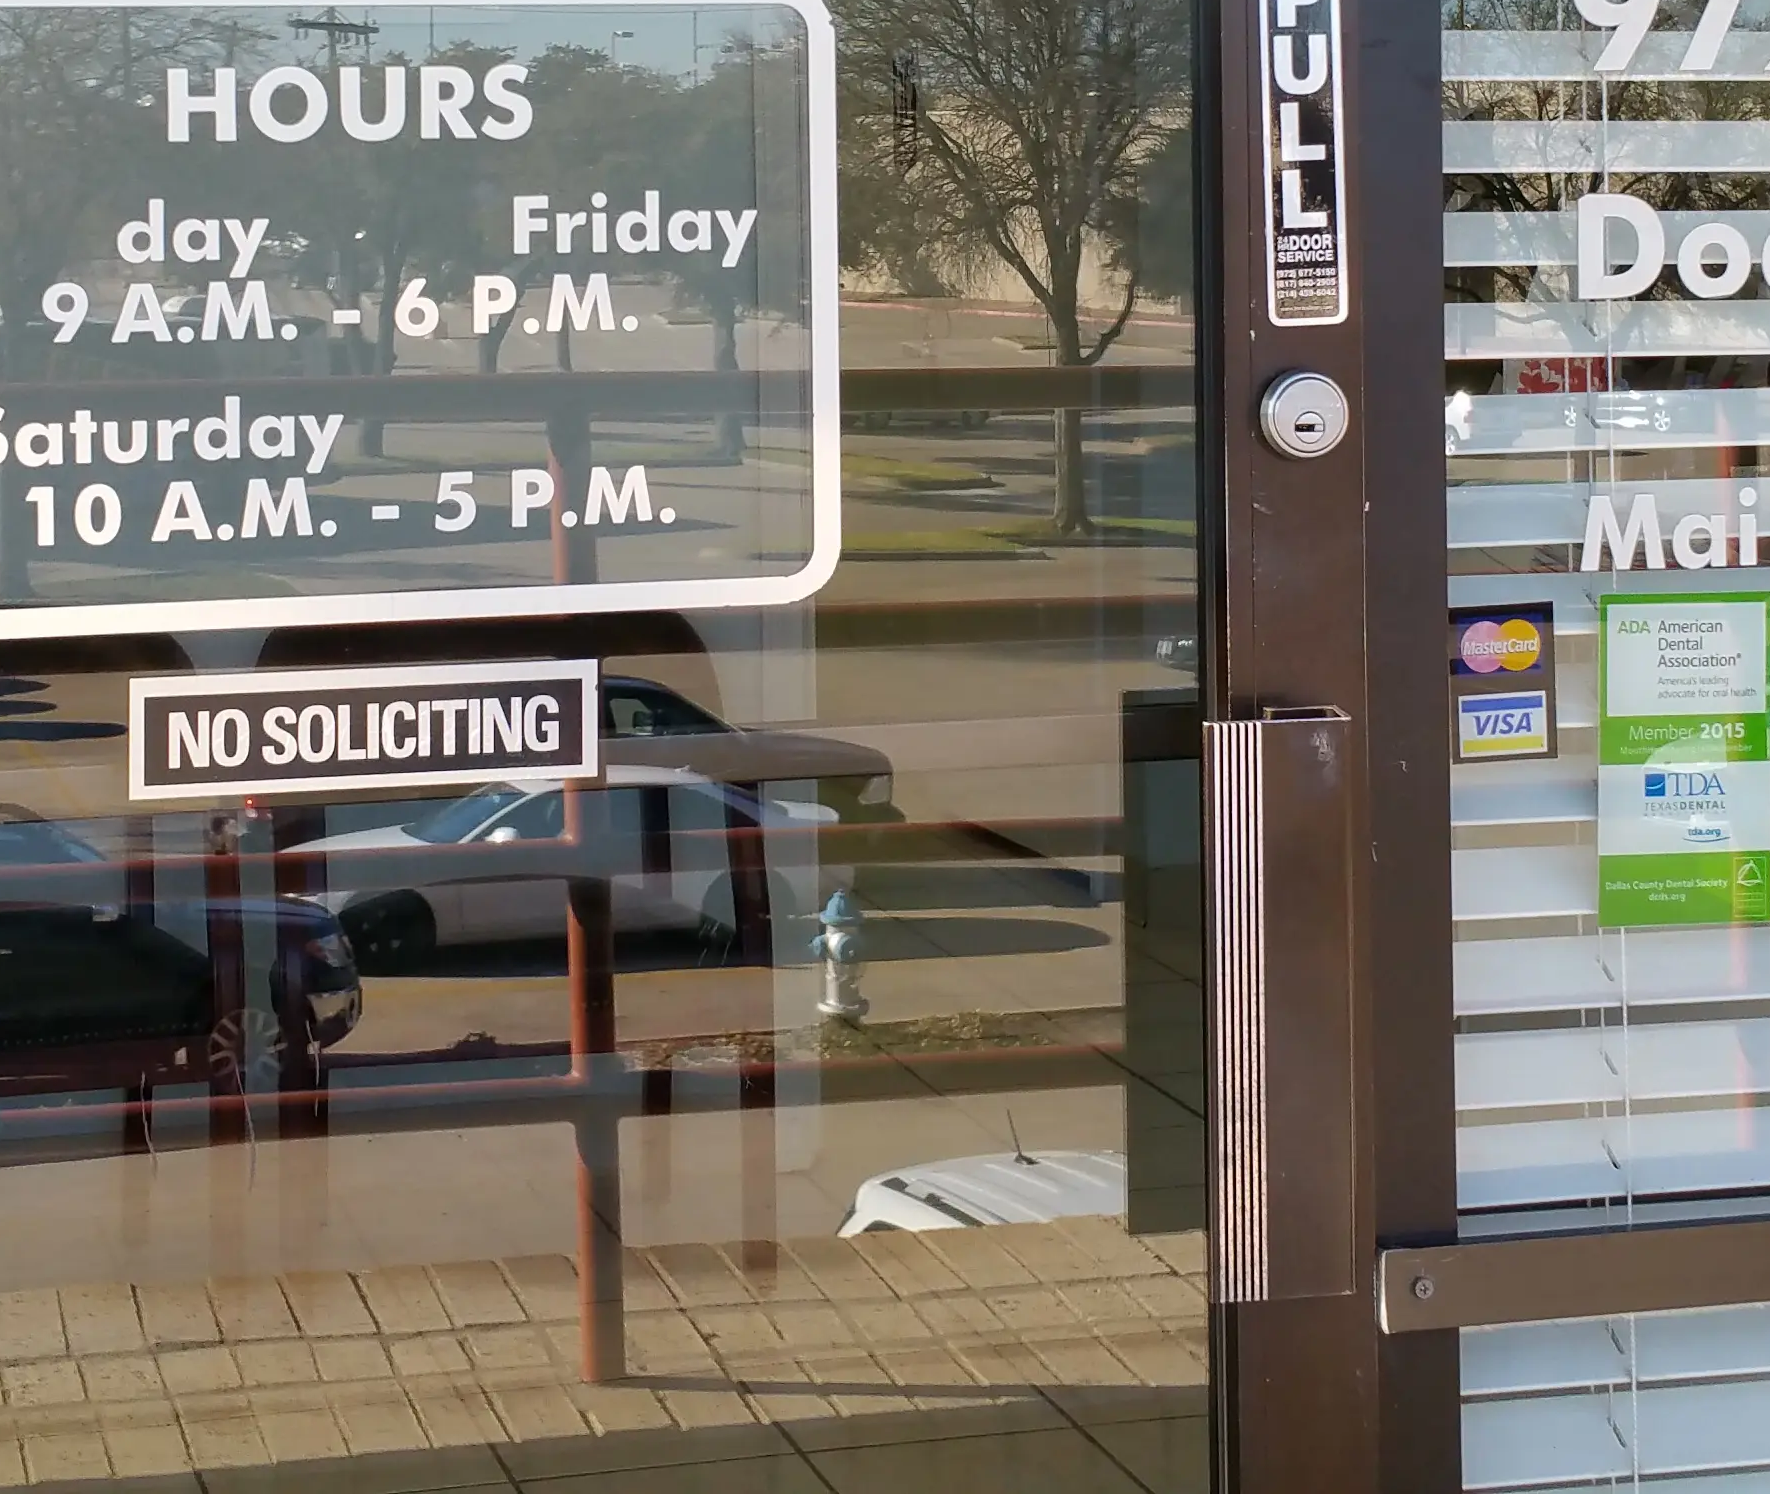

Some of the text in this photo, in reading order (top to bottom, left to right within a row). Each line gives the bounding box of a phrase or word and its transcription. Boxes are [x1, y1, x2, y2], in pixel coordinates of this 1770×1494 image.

[165, 64, 534, 144] HOURS
[116, 189, 759, 279] day Friday
[1290, 234, 1333, 251] DOOR
[1277, 250, 1334, 263] SERVICE
[41, 282, 89, 343] 9
[112, 280, 299, 344] A.M.
[394, 278, 439, 338] 6
[472, 273, 639, 335] P.M.
[25, 483, 121, 547] 10
[151, 477, 339, 543] A.M.
[434, 470, 475, 533] 5
[511, 463, 677, 530] P.M.
[1581, 486, 1761, 572] Mai
[1618, 619, 1723, 634] ADA American
[1463, 638, 1538, 656] MasterCard
[1658, 636, 1703, 651] Dental
[167, 693, 561, 771] NO SOLICITING
[1473, 712, 1533, 737] VISA
[1629, 722, 1745, 740] Member 2015
[1667, 772, 1726, 797] TDA
